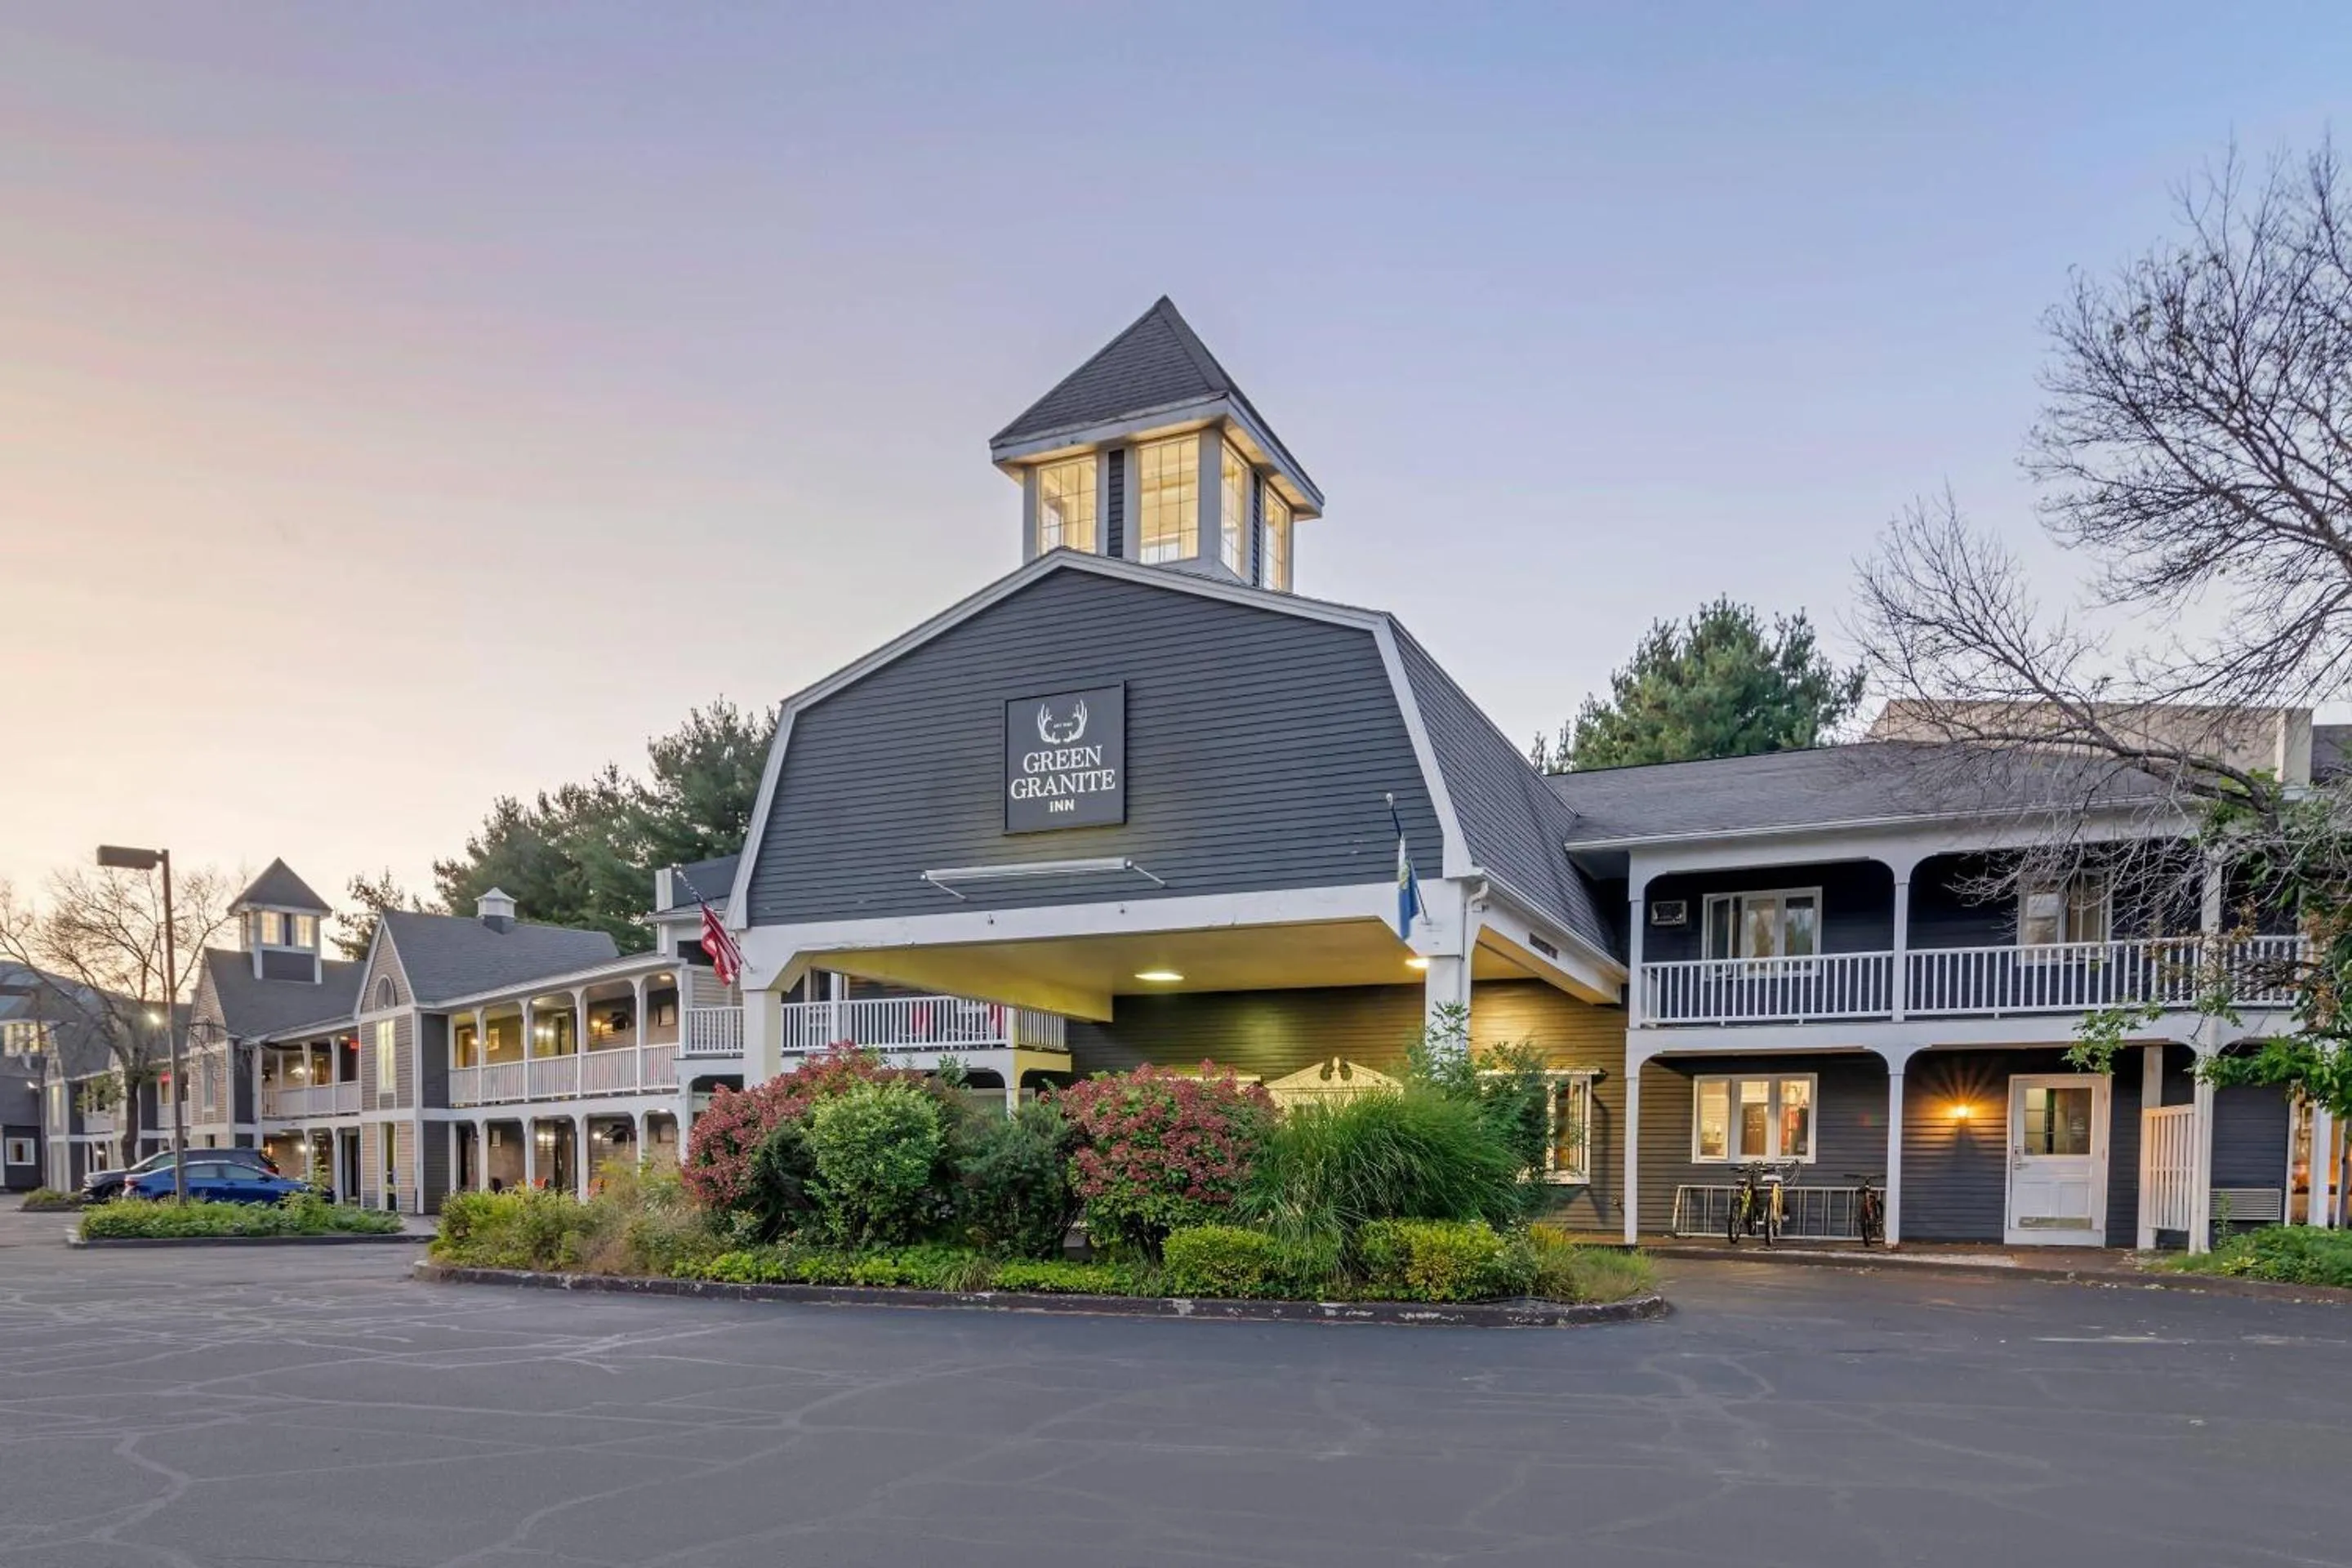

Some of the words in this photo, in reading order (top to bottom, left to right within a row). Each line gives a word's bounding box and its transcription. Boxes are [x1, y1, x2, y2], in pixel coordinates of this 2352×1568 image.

[1023, 745, 1102, 774] GREEN
[1010, 769, 1116, 800] GRANITE
[1049, 799, 1075, 813] INN
